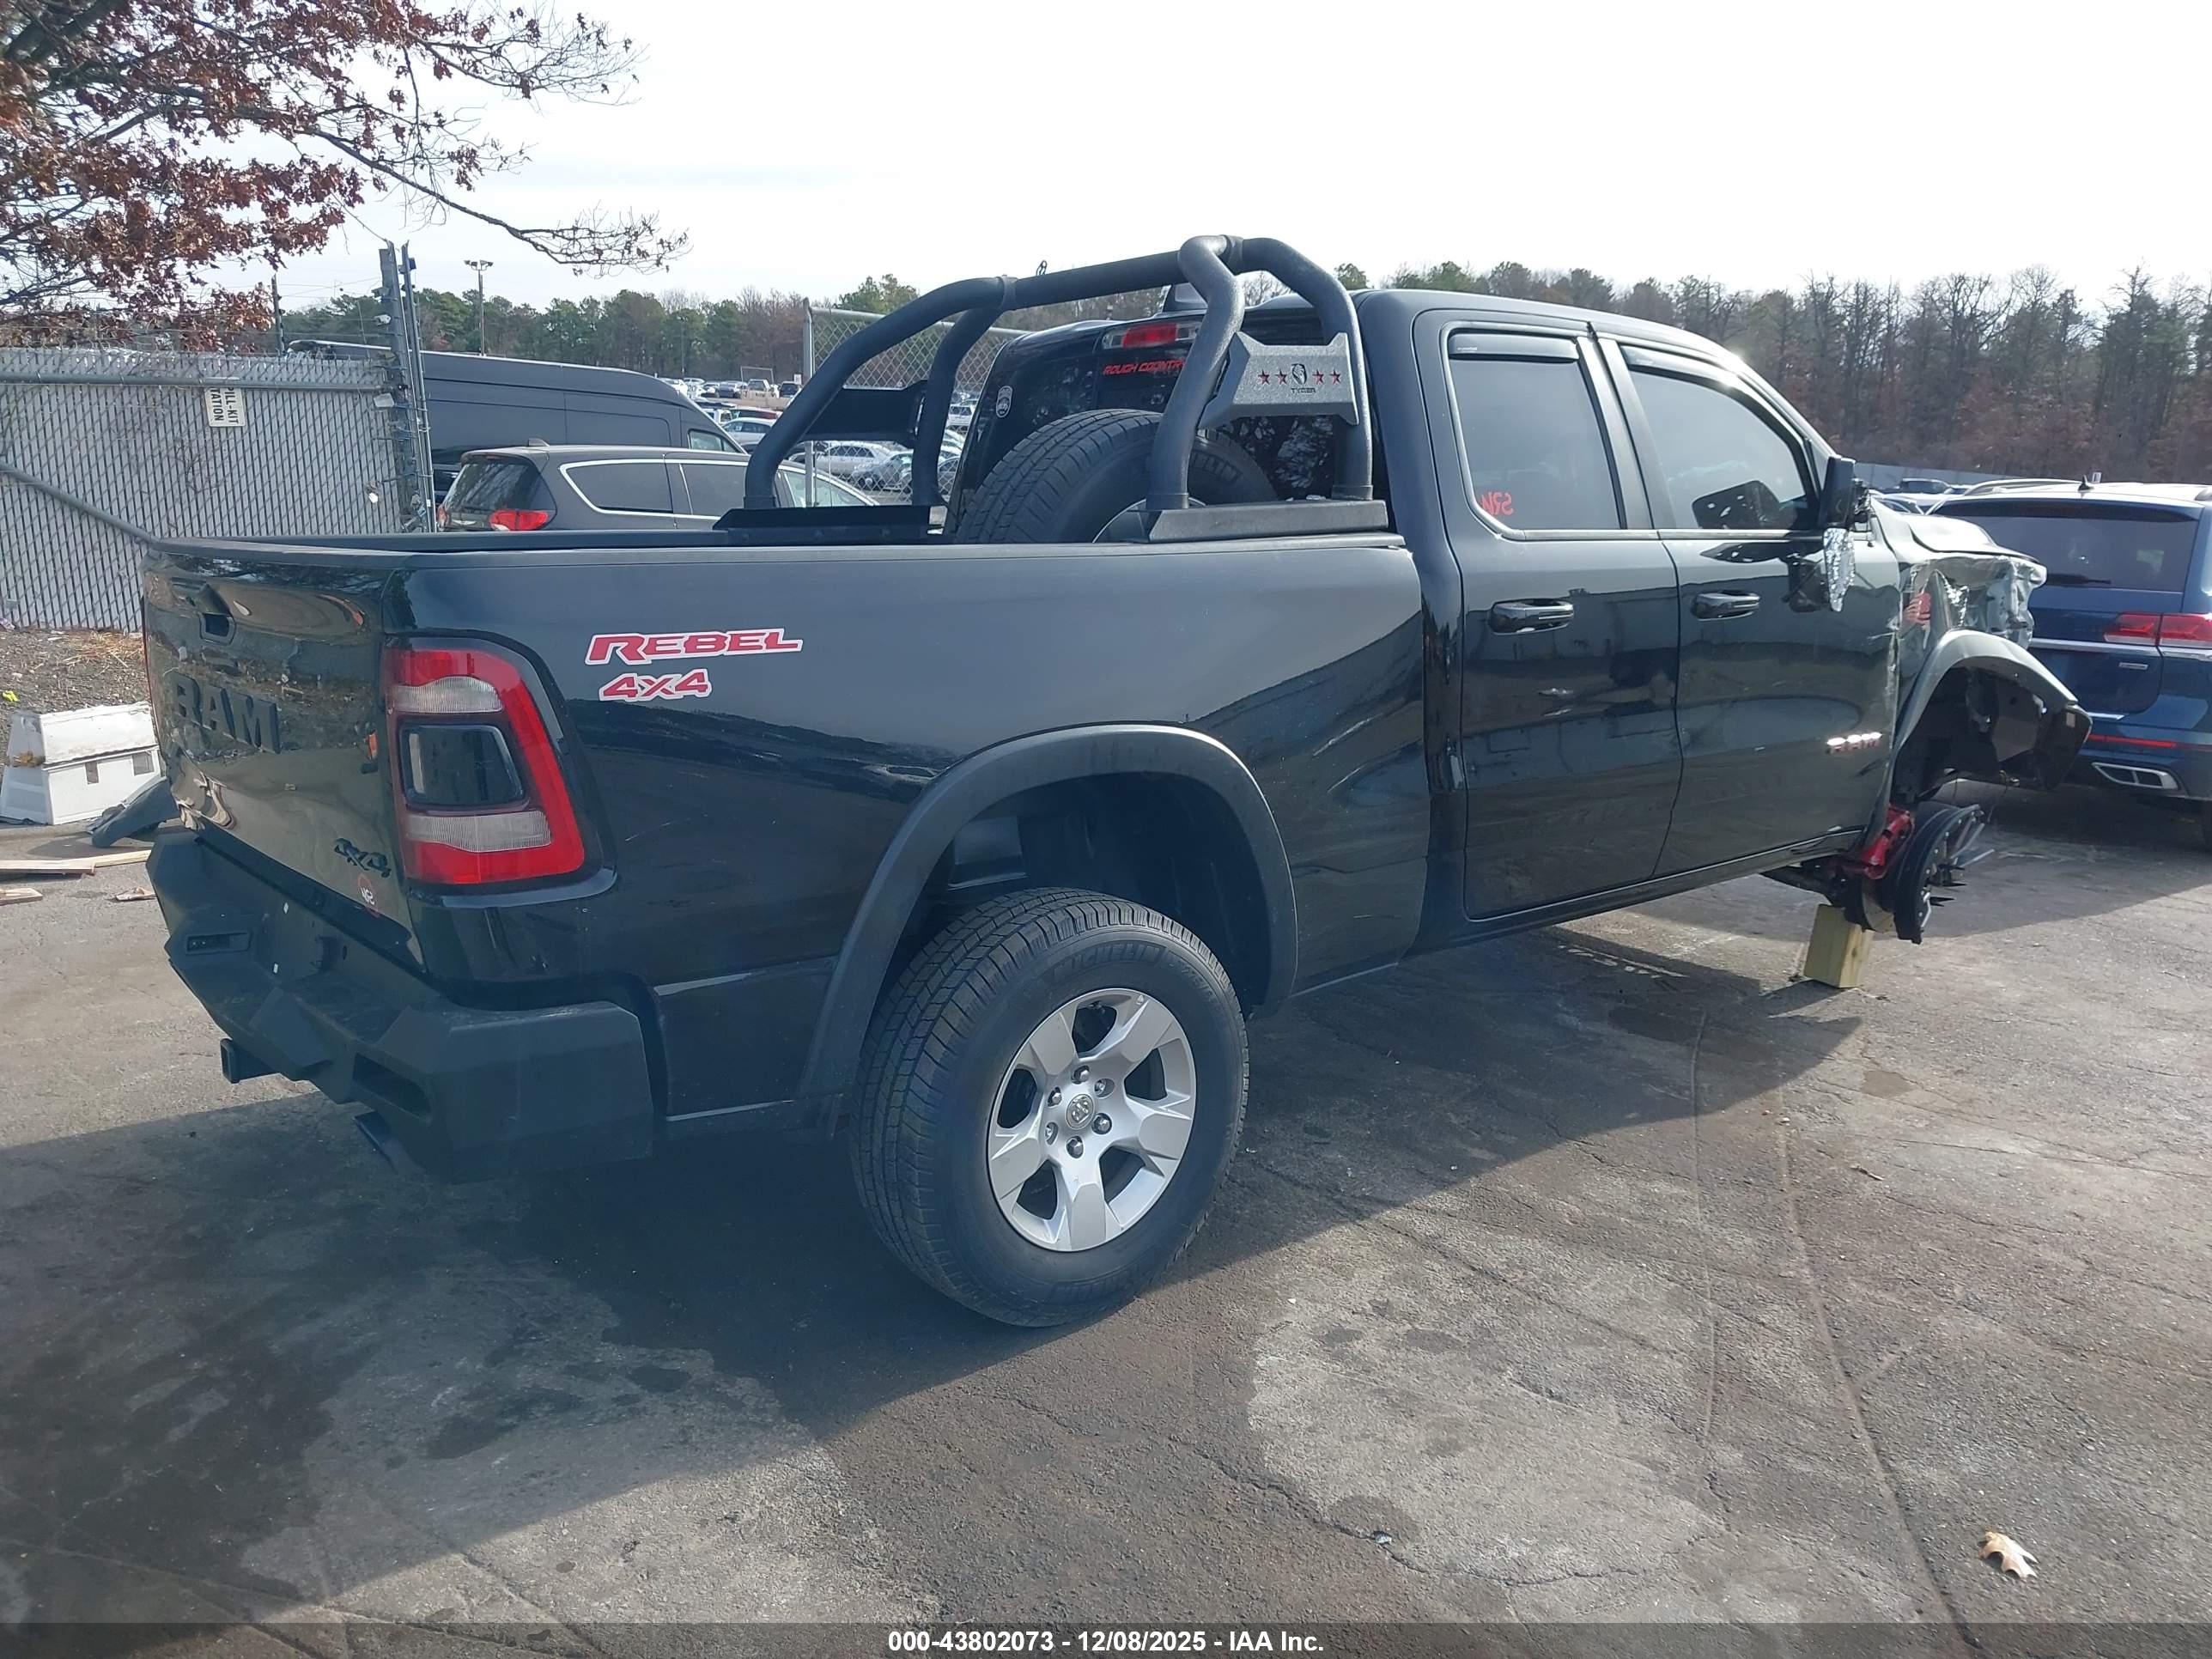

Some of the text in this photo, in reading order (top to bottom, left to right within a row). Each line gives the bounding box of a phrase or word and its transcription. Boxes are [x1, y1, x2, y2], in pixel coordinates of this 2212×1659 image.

[1103, 363, 1139, 375] ROUGH
[210, 387, 224, 421] TATION
[224, 387, 239, 424] PILL-KIT
[585, 628, 804, 665] REBEL
[171, 672, 282, 754] RAM
